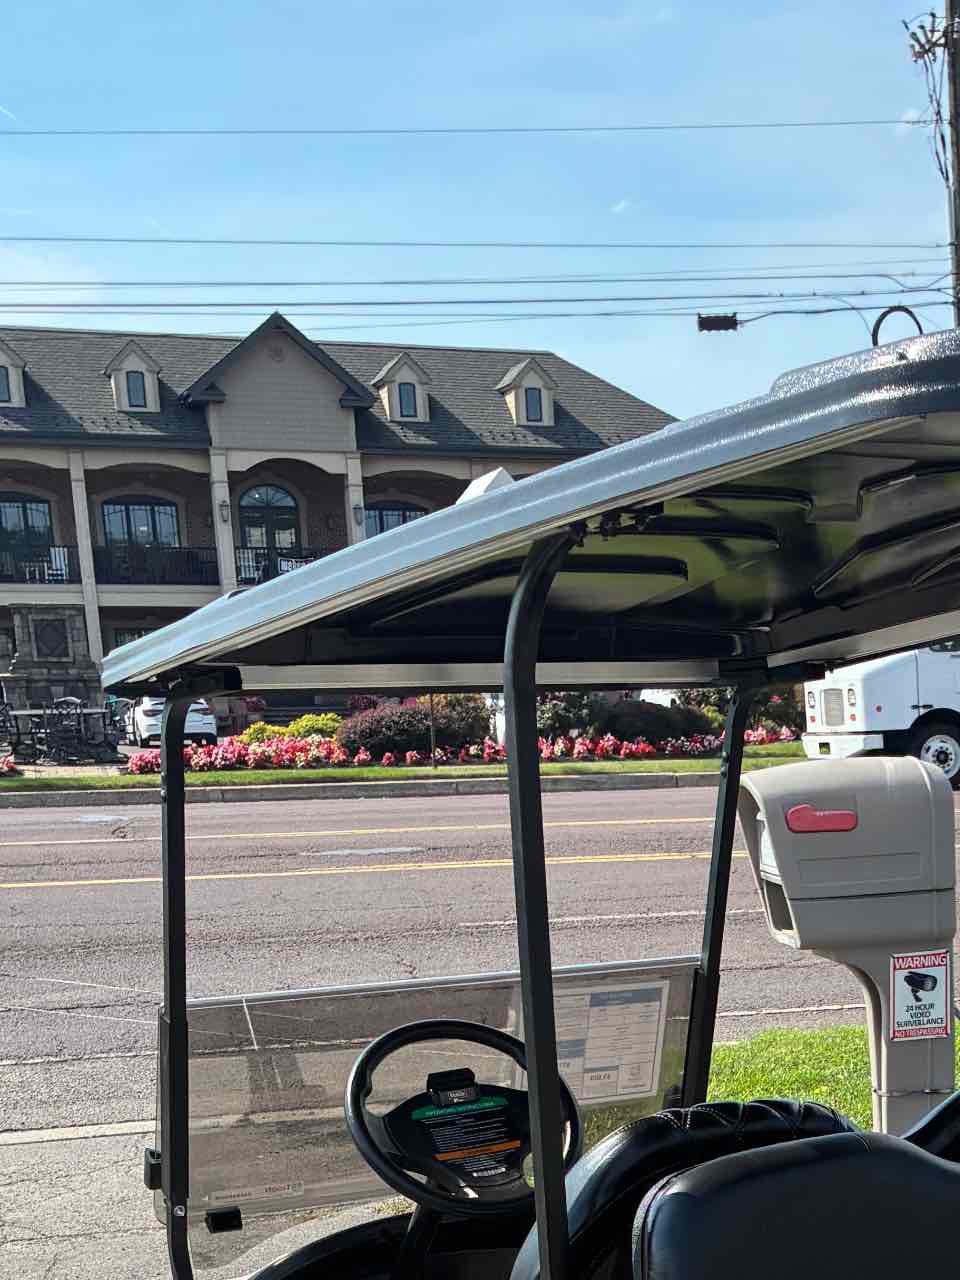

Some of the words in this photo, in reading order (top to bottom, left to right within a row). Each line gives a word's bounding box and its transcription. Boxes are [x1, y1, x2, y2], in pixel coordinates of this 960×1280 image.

[895, 954, 946, 969] WARNING
[915, 1003, 934, 1011] HOUR
[909, 1011, 931, 1019] VIDEO
